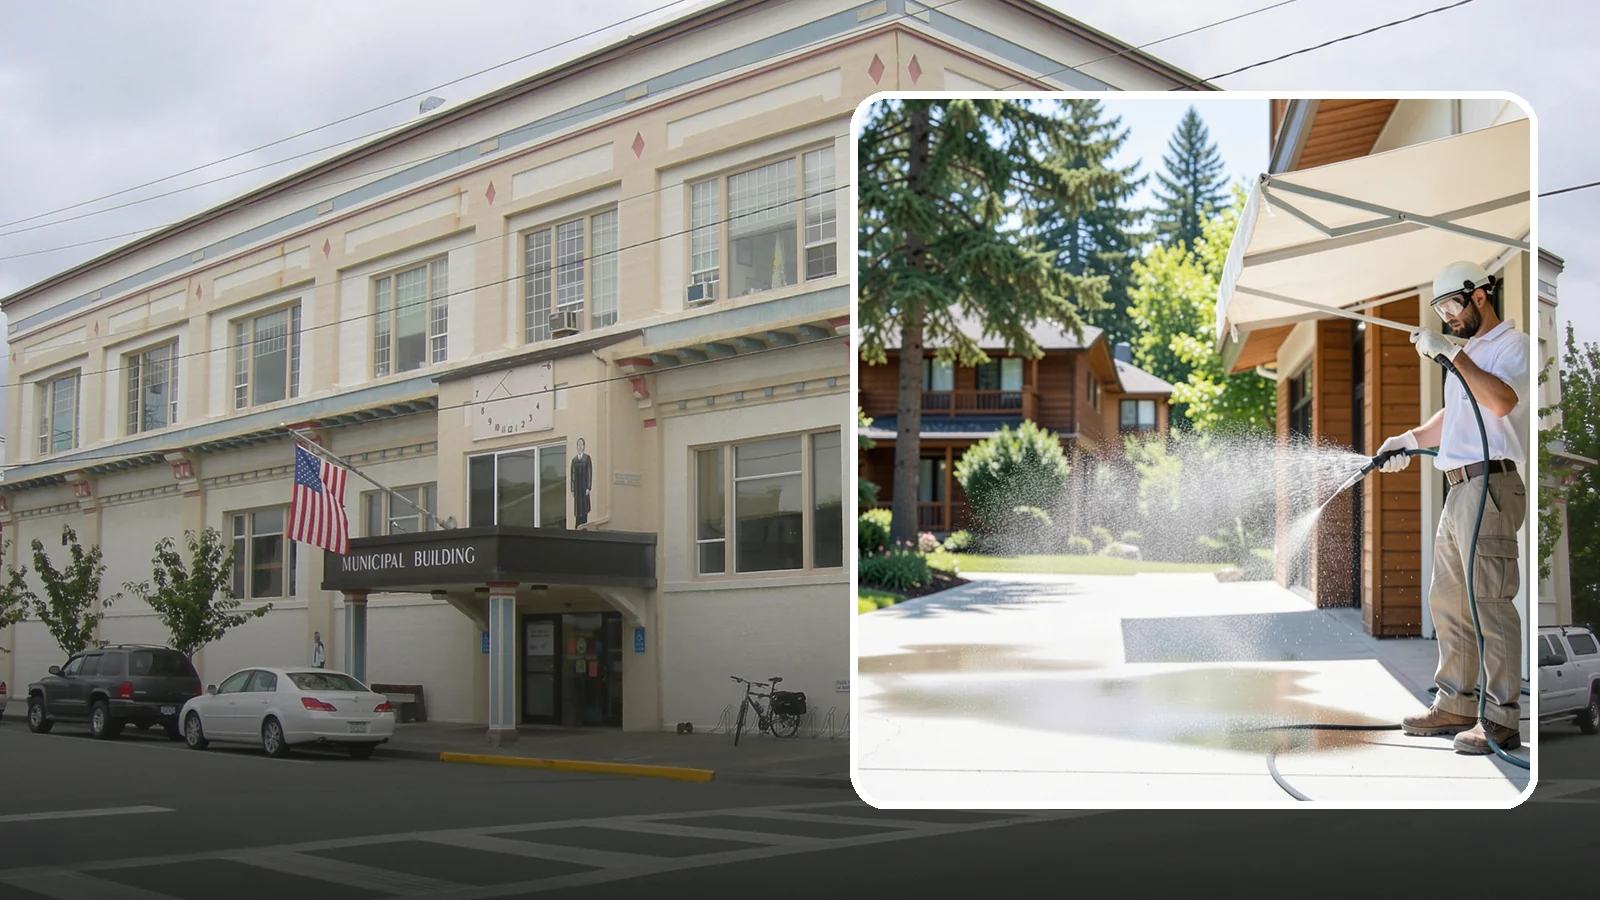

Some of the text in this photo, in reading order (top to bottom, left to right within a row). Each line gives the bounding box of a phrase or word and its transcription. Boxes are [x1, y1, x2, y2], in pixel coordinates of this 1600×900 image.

[494, 423, 500, 432] 10
[507, 425, 513, 433] 12
[342, 546, 475, 572] MUNICIPAL BUILDING
